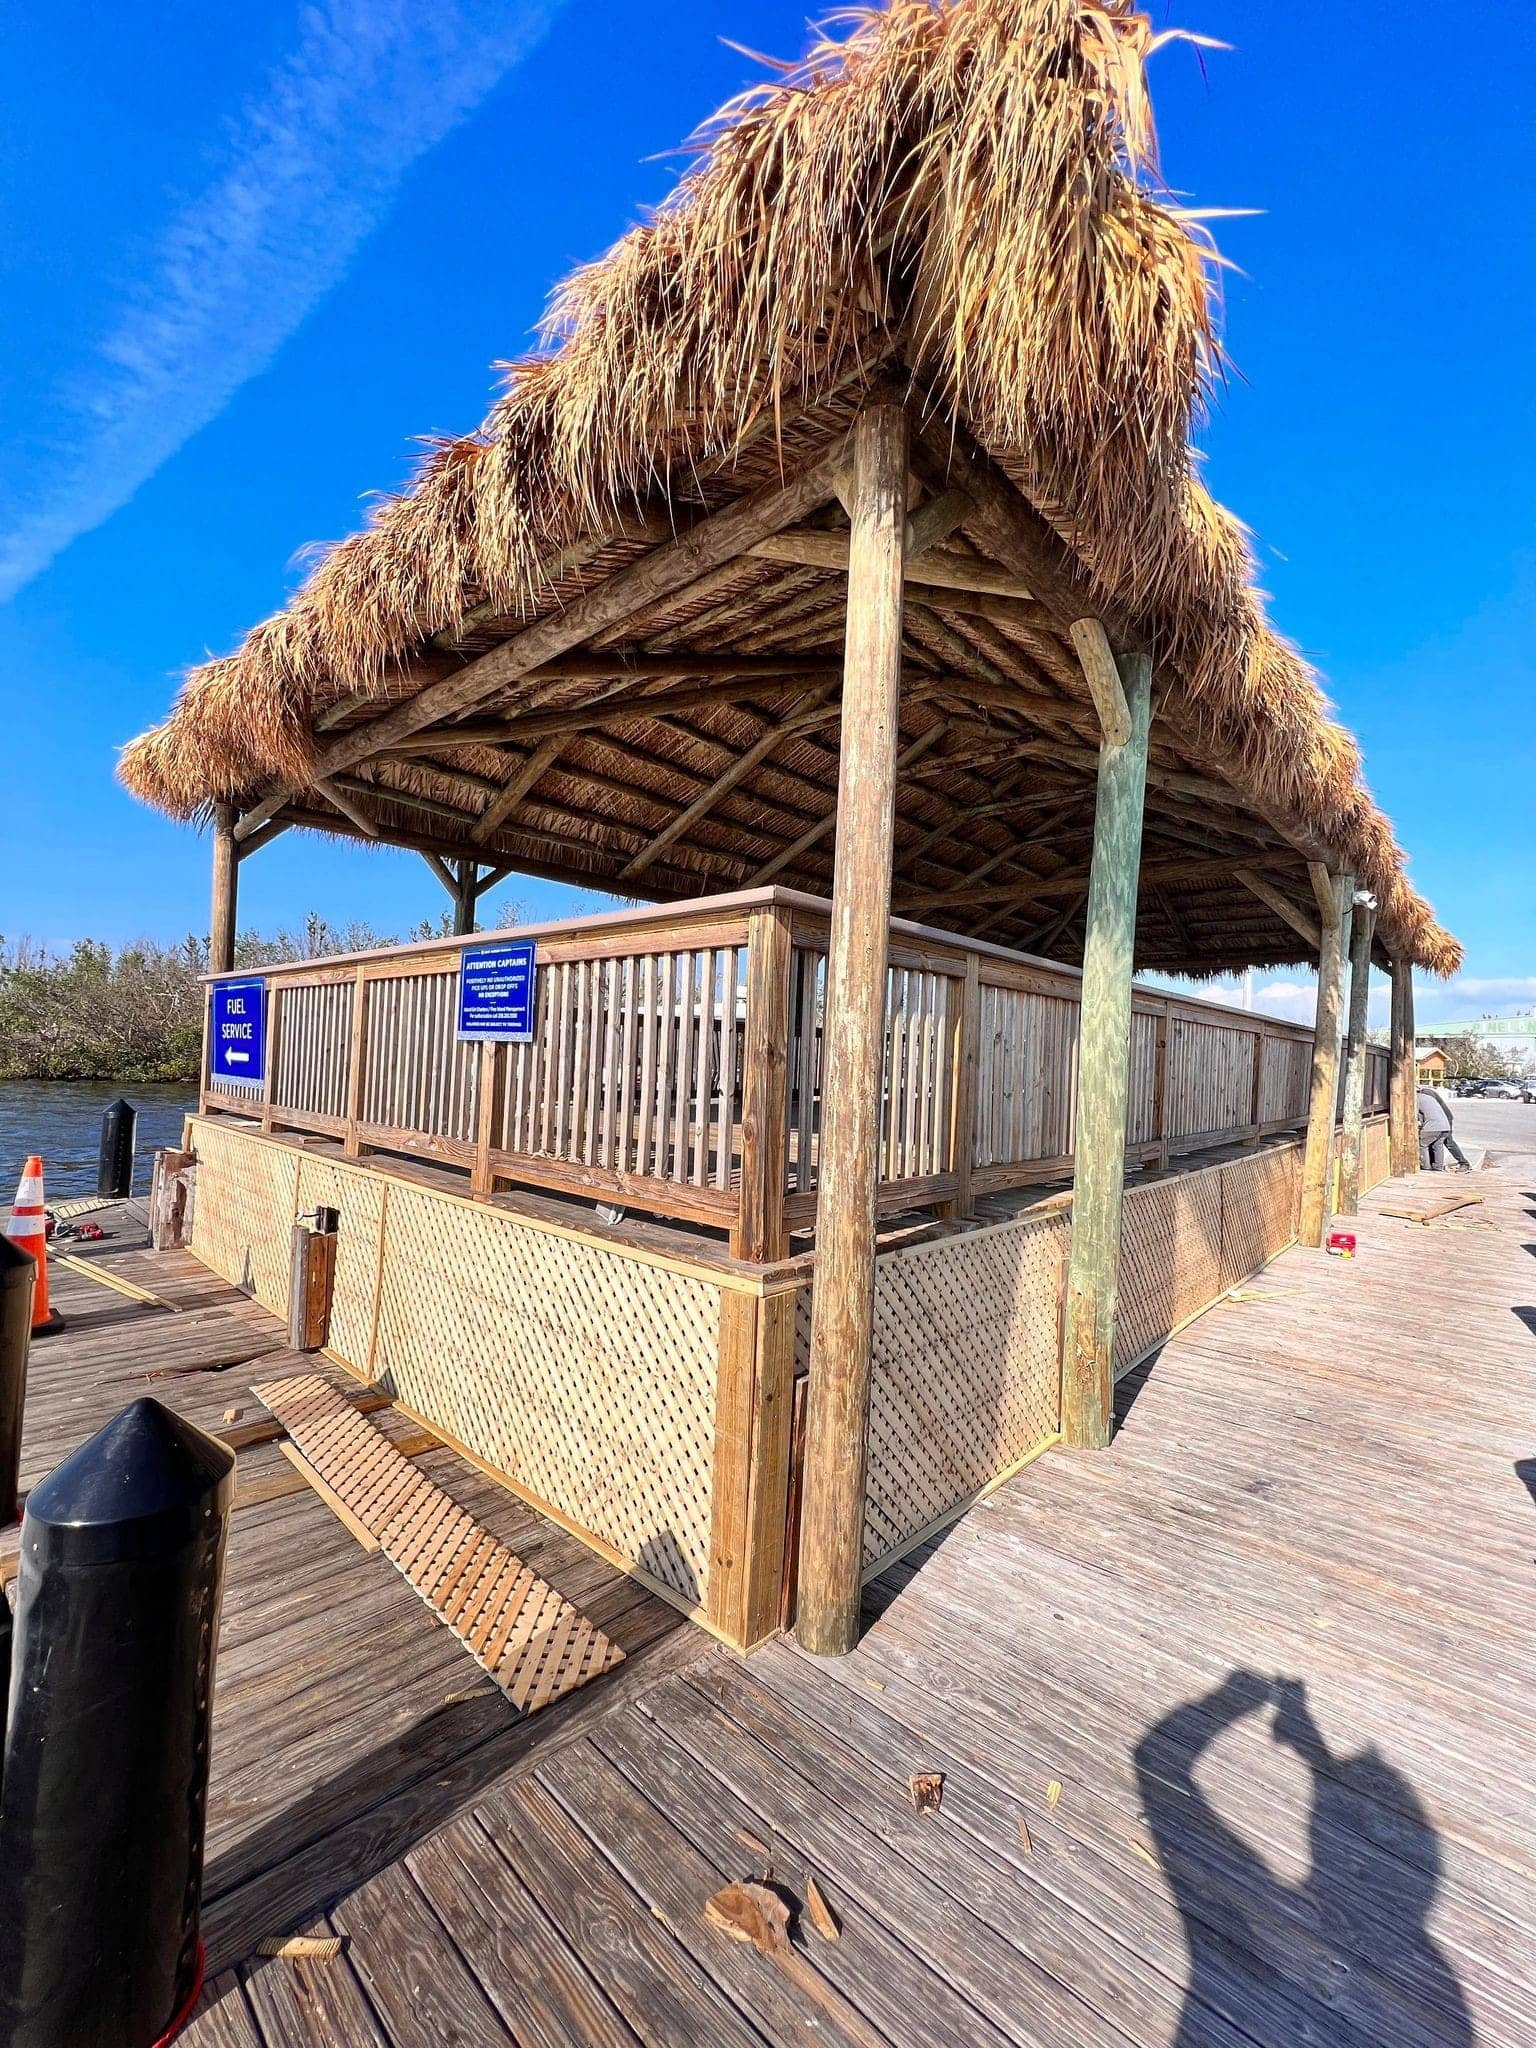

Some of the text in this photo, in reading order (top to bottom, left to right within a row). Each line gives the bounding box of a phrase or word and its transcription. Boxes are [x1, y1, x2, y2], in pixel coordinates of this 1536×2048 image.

[466, 958, 526, 970] ATTENTION CAPTAINS
[227, 998, 246, 1014] FUEL
[222, 1023, 253, 1039] SERVICE
